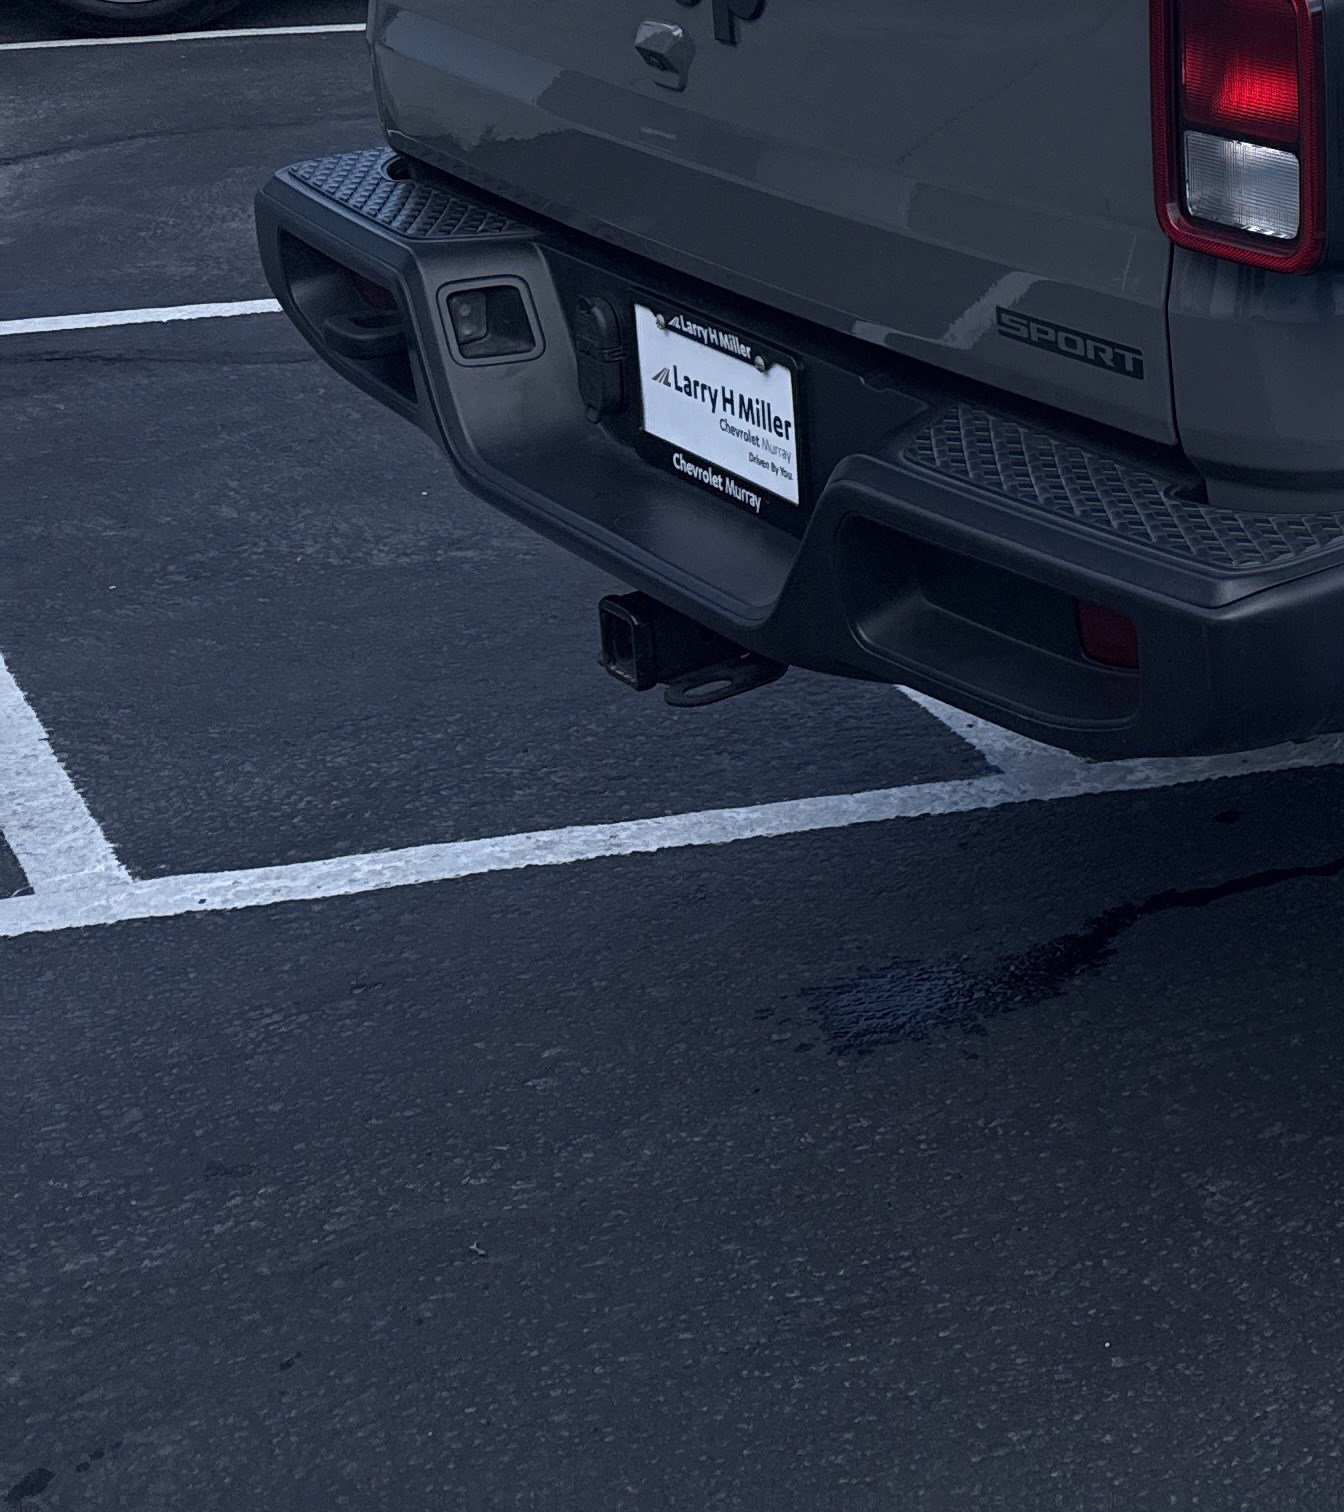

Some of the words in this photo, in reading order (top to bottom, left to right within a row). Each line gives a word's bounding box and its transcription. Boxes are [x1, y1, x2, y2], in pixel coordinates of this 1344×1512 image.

[680, 314, 708, 345] Larry
[708, 326, 720, 346] H
[719, 331, 751, 360] Miller
[998, 312, 1144, 373] SPORT
[672, 364, 718, 414] Larry
[721, 387, 736, 417] H
[738, 396, 792, 441] Miller
[719, 417, 761, 449] Chevrolet
[761, 437, 792, 464] Murray
[672, 452, 724, 492] Chevrolet
[725, 476, 762, 514] Murray
